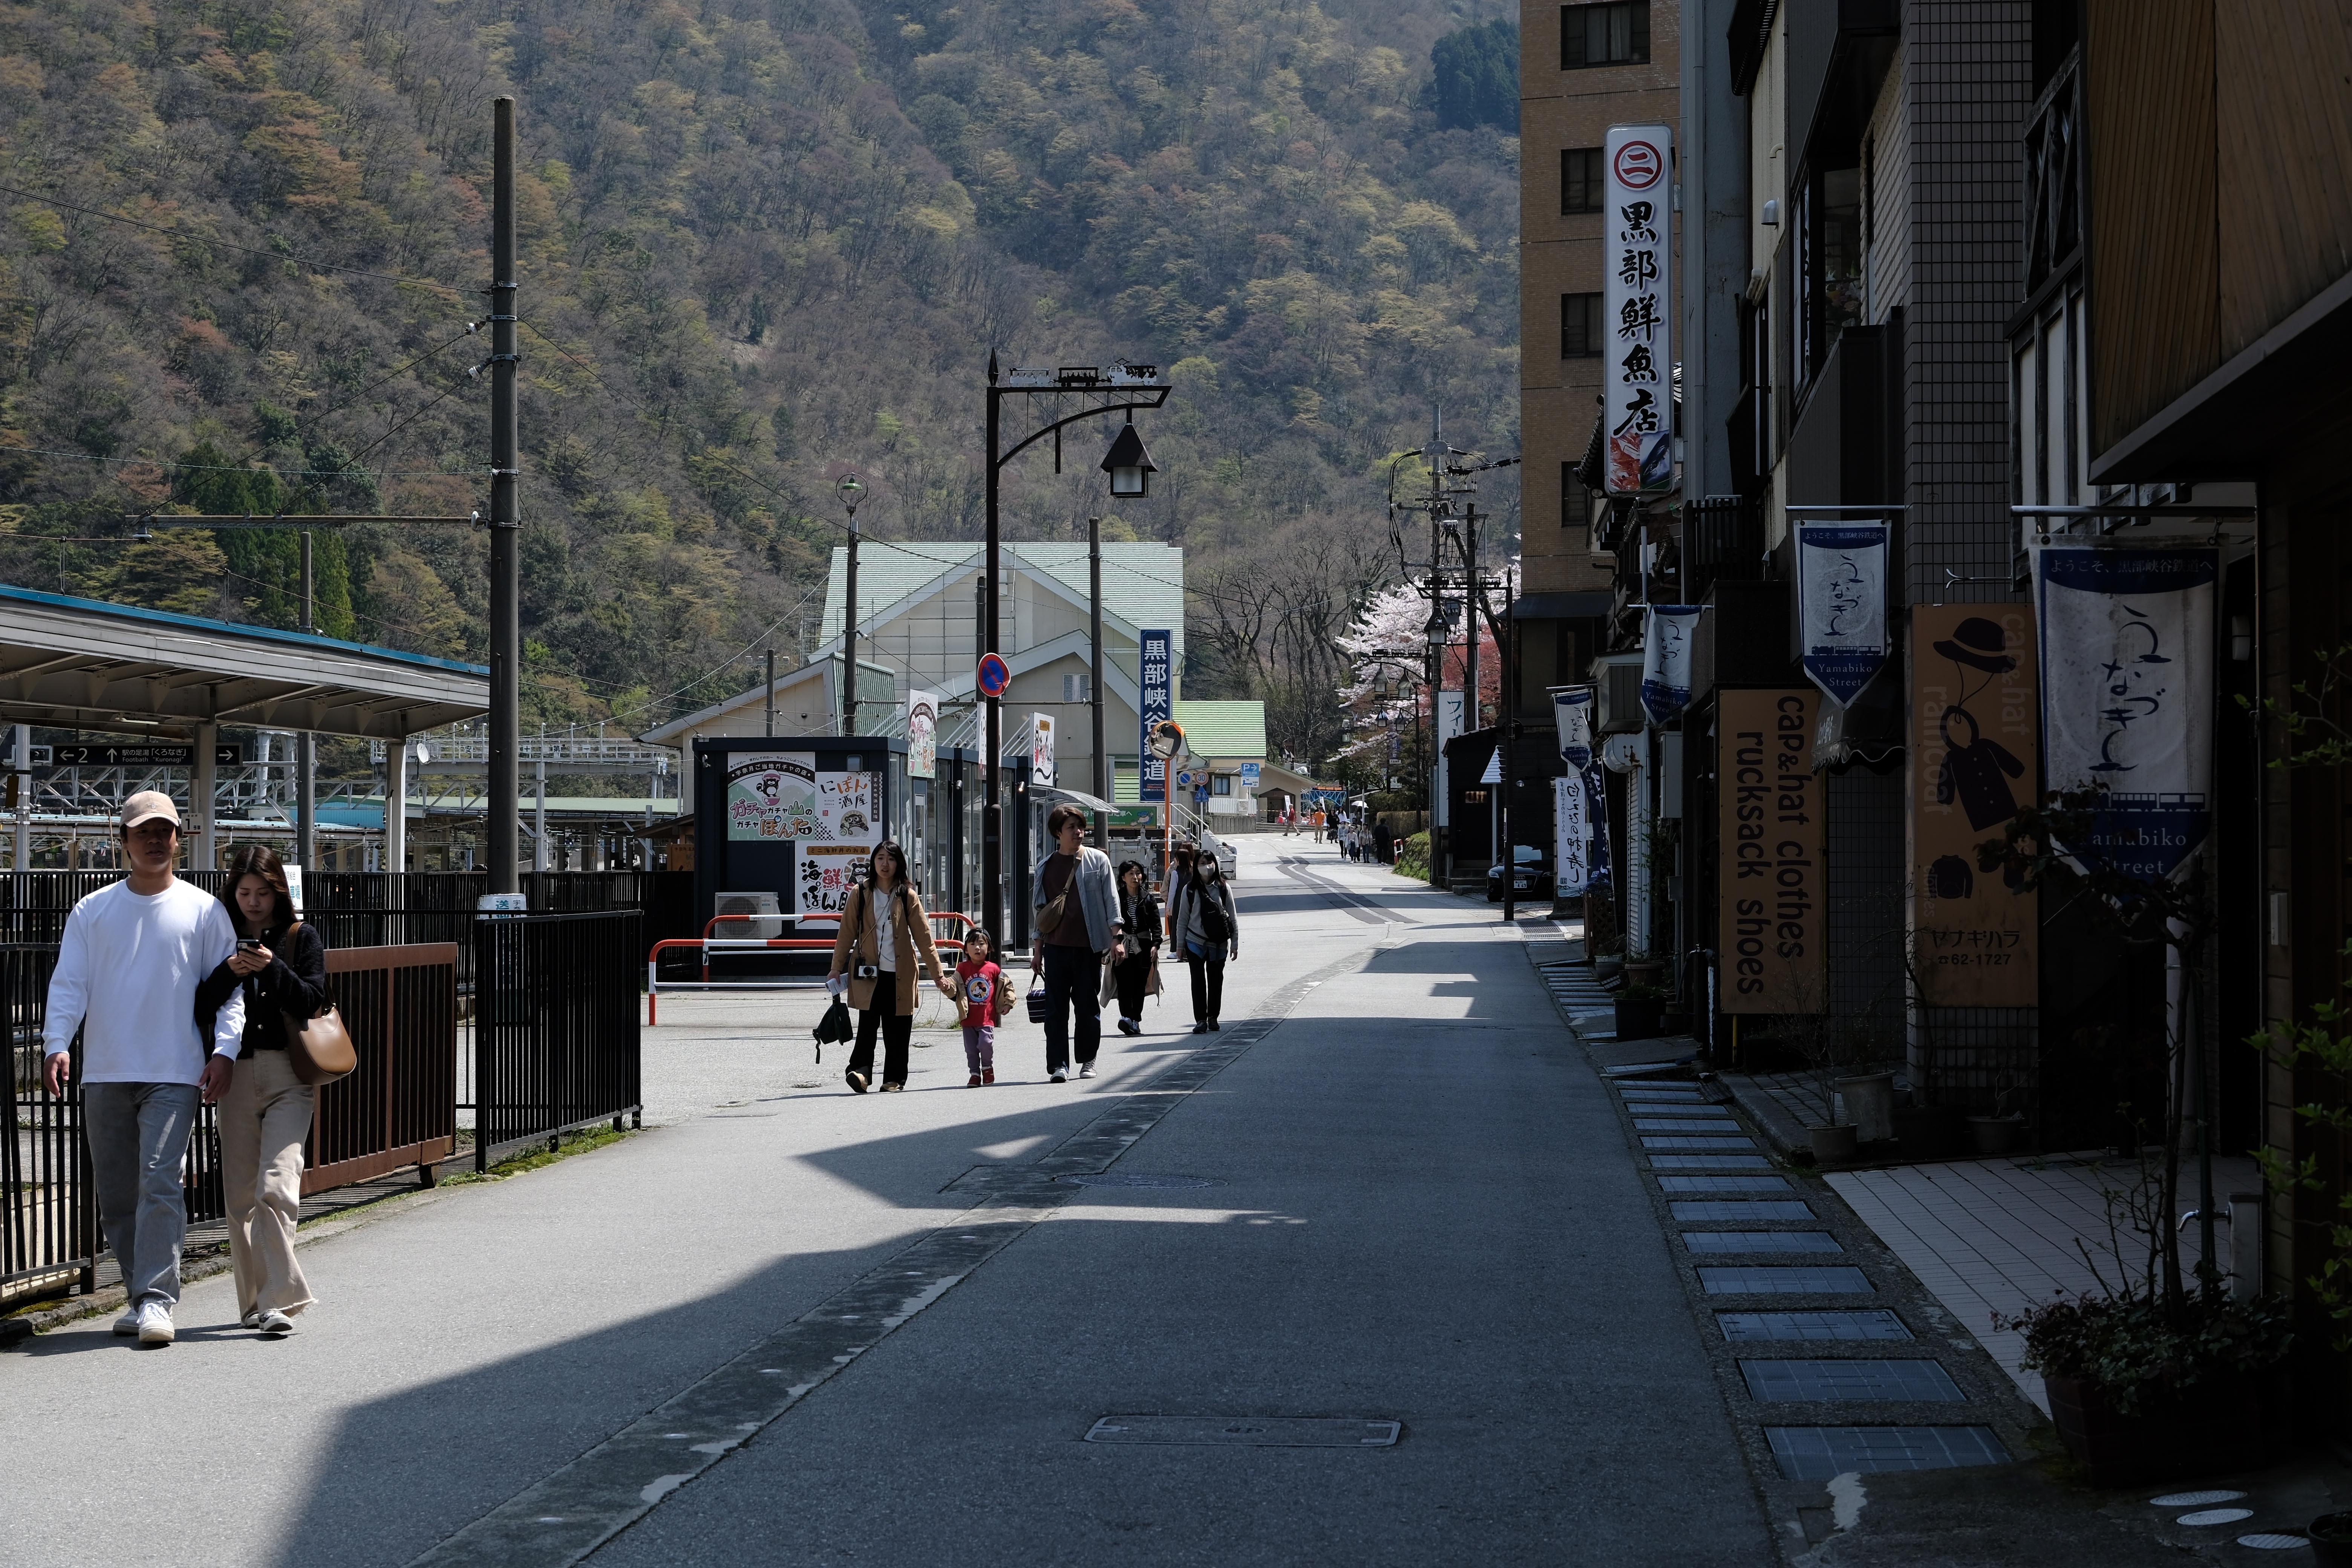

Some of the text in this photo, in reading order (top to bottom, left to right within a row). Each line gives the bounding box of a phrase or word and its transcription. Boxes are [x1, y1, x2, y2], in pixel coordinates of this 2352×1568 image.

[1614, 201, 1660, 436] 黒部鮮魚店
[2050, 559, 2213, 573] ようこそ、黒部峡谷鉄道へ
[1818, 663, 1872, 672] Yamabiko
[1829, 677, 1862, 686] Street
[1646, 692, 1682, 706] Yamabiko
[78, 748, 88, 763] 2
[735, 763, 807, 776] 宇奈月ご当地ガチャの店
[820, 776, 868, 794] にぽん
[730, 798, 813, 819] ガチャガチャ山の
[839, 793, 868, 809] 酒屋
[185, 818, 190, 830] 1
[737, 815, 813, 838] ガチャぽんた
[1776, 696, 1812, 958] cap&hat clothes
[1737, 732, 1772, 995] rucksack shoes
[1931, 929, 2020, 948] ヤナギハラ
[1951, 954, 2011, 965] 62-1727
